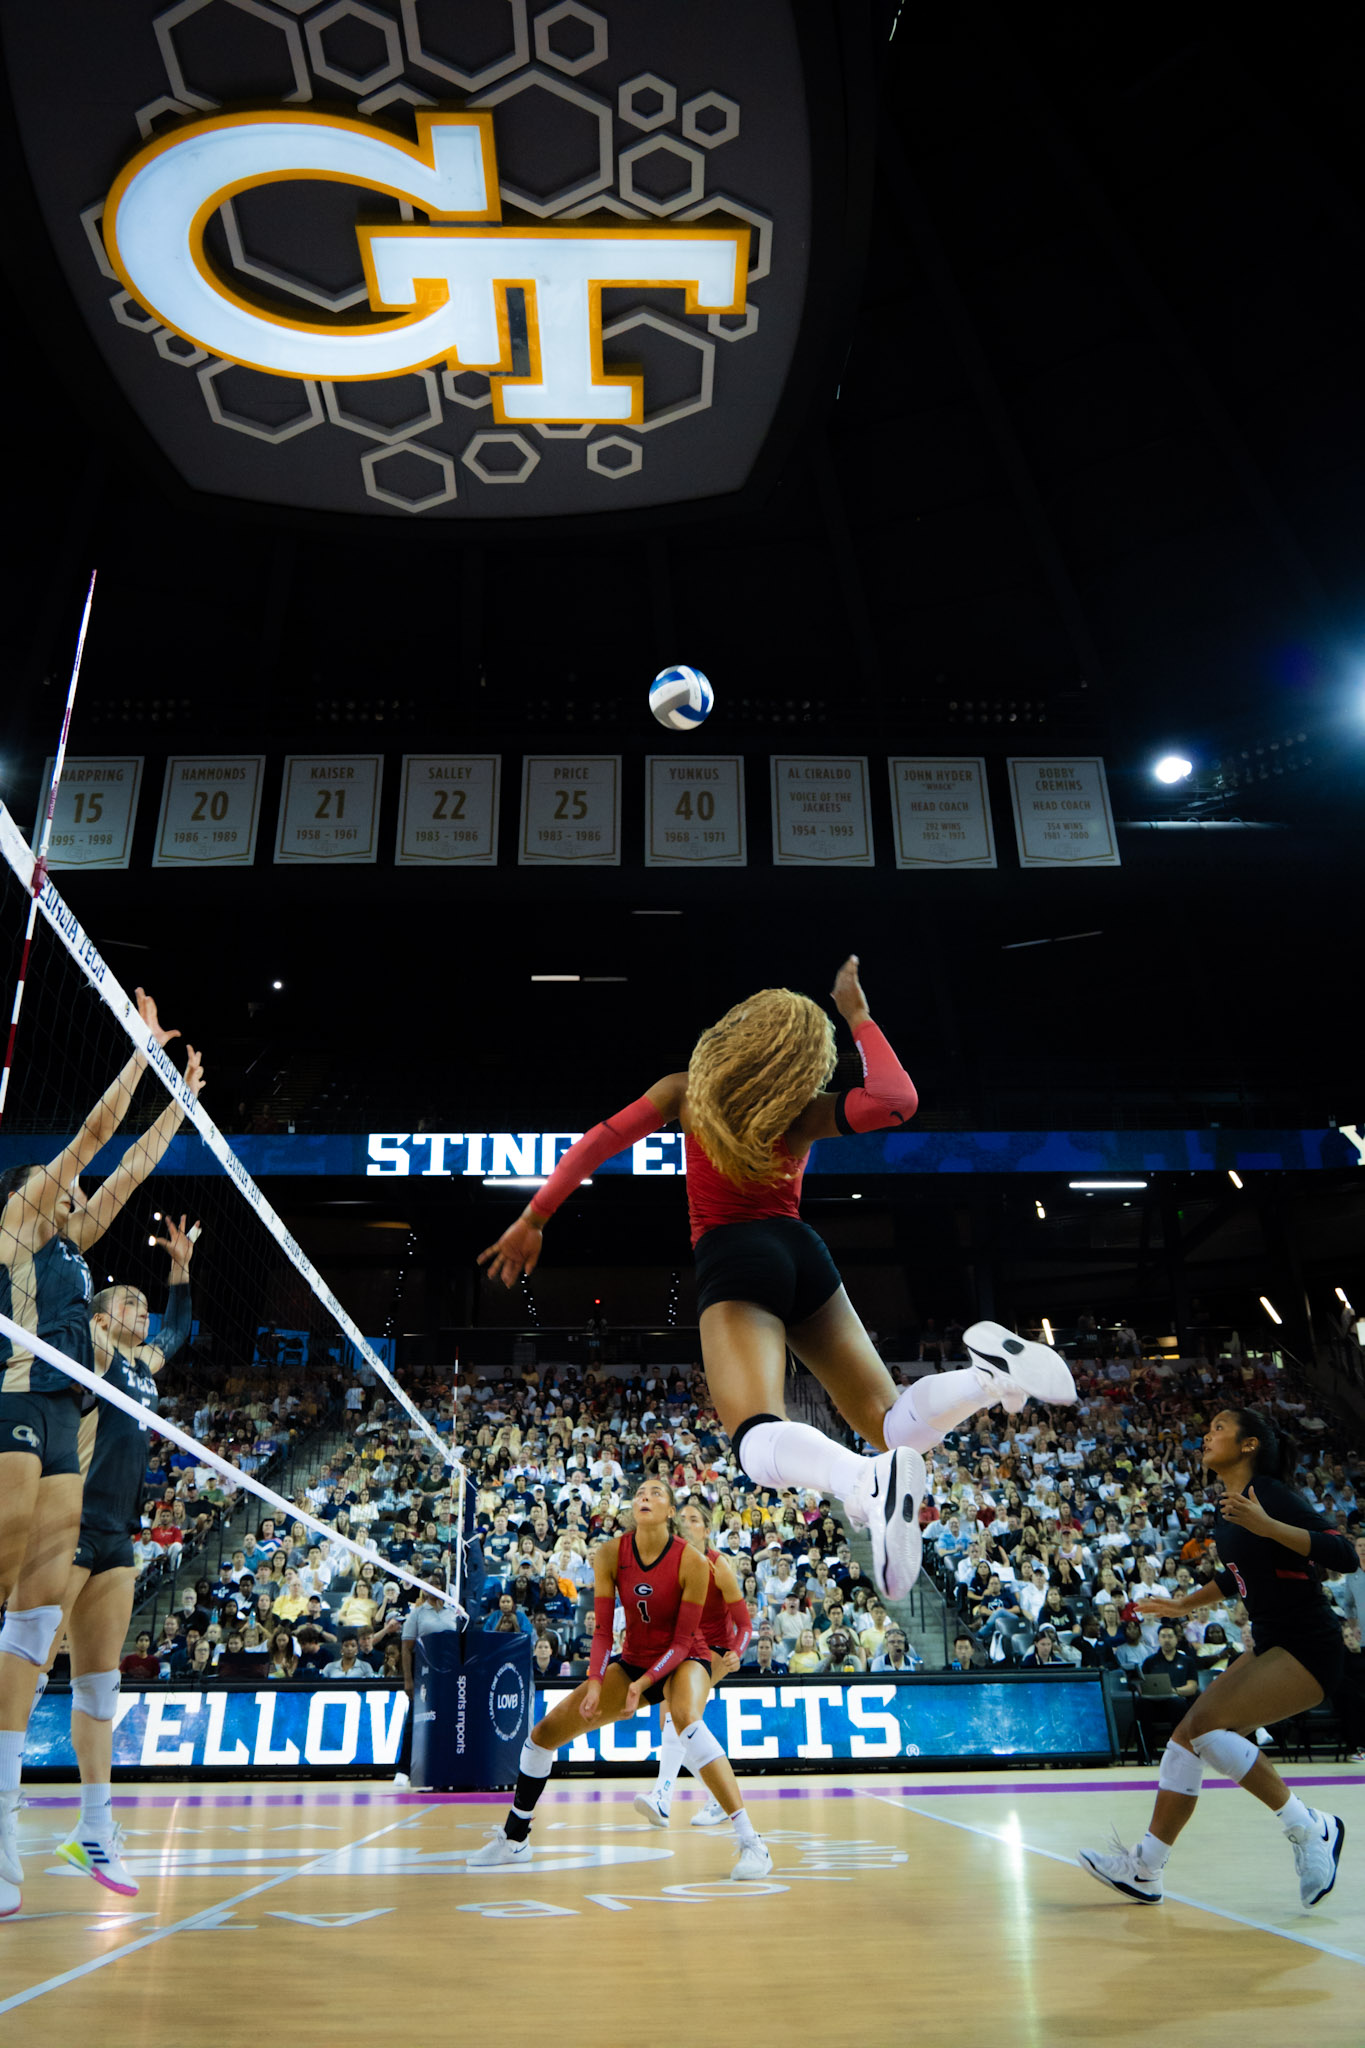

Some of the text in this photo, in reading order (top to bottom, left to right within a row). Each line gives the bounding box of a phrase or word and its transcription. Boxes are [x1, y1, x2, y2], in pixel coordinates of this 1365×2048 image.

[61, 768, 124, 782] HARPRING
[181, 766, 246, 781] HAMMONDS
[310, 766, 355, 780] KAISER
[428, 767, 473, 780] SALLEY
[553, 767, 590, 780] PRICE
[668, 768, 720, 780] YUNKUS
[788, 768, 852, 780] AL CIRALDO
[904, 770, 973, 782] JOHN HYDER
[1038, 768, 1074, 779] BOBBY
[1035, 780, 1083, 792] CREMINS
[790, 792, 852, 803] VOICE OF THE
[73, 792, 104, 824] 15
[190, 790, 229, 822] 20
[314, 789, 346, 820] 21
[432, 790, 466, 820] 22
[553, 790, 588, 820] 25
[674, 790, 714, 821] 40
[802, 802, 842, 813] JACKETS
[911, 802, 969, 812] HEAD COACH
[1032, 800, 1091, 810] HEAD COACH
[296, 829, 320, 841] 1958
[334, 828, 358, 840] 1961
[415, 830, 440, 842] 1983
[453, 830, 478, 842] 1986
[538, 830, 562, 841] 1983
[576, 830, 601, 841] 1986
[791, 824, 817, 836] 1954
[830, 824, 854, 836] 1993
[51, 834, 76, 846] 1995
[88, 834, 113, 846] 1998
[174, 832, 199, 844] 1986
[212, 831, 237, 842] 1989
[665, 832, 690, 843] 1968
[704, 832, 726, 843] 1971
[38, 875, 108, 984] EORGIA TECH
[634, 1583, 654, 1596] G
[636, 1600, 651, 1624] 1
[654, 1649, 674, 1672] GEORGIA
[496, 1692, 518, 1710] LOVB
[455, 1674, 467, 1754] sports imports
